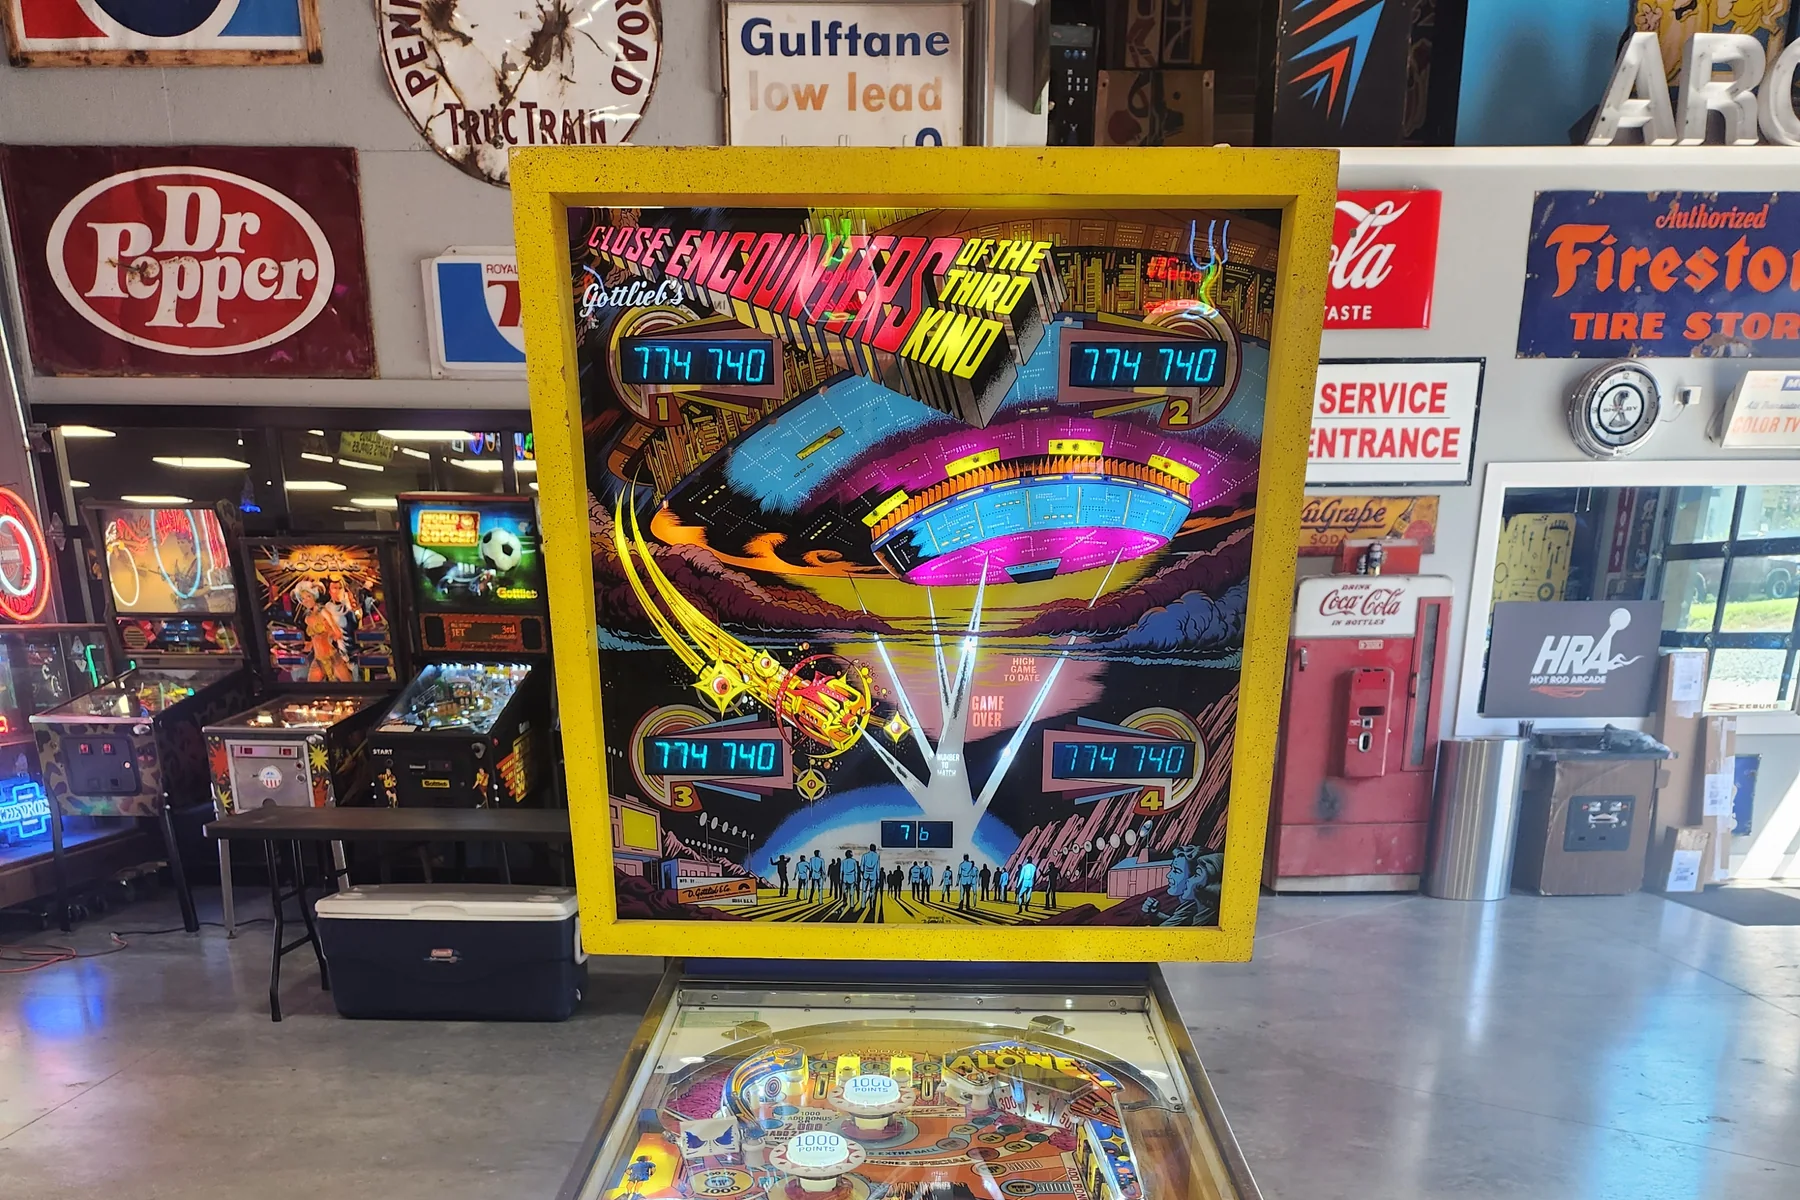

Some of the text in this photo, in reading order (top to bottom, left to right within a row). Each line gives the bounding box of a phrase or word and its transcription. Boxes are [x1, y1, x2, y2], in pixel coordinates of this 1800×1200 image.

[741, 17, 950, 57] Gulftane
[749, 70, 942, 112] low lead
[157, 185, 260, 253] Dr
[1655, 202, 1769, 229] Authorized
[587, 226, 671, 267] CLOSE
[955, 238, 1053, 273] OF THE
[84, 222, 316, 328] Pepper
[579, 279, 685, 318] Gottlieb's
[664, 229, 964, 352] ENCOUNTERS
[938, 269, 1031, 314] THIRD
[1570, 313, 1666, 340] TIRE
[901, 307, 1004, 380] KIND
[634, 347, 766, 383] 774 740
[1084, 348, 1217, 383] 774 740
[1319, 382, 1448, 414] SERVICE
[1168, 400, 1190, 425] 2
[1302, 499, 1387, 533] uGrape
[1012, 657, 1035, 665] HIGH
[1531, 635, 1610, 675] HRA
[1004, 674, 1040, 682] TO DATE
[1010, 665, 1036, 674] GAME
[1529, 676, 1607, 684] HOT ROD ARCADE
[971, 696, 1004, 711] GAME
[972, 712, 1002, 727] OVER
[654, 742, 776, 770] 774 740
[1064, 745, 1186, 773] 774 740
[674, 786, 693, 807] 3
[1140, 789, 1163, 811] 4
[950, 1053, 1078, 1071] ALONE
[795, 1134, 839, 1147] 1000
[702, 1186, 741, 1194] 1000
